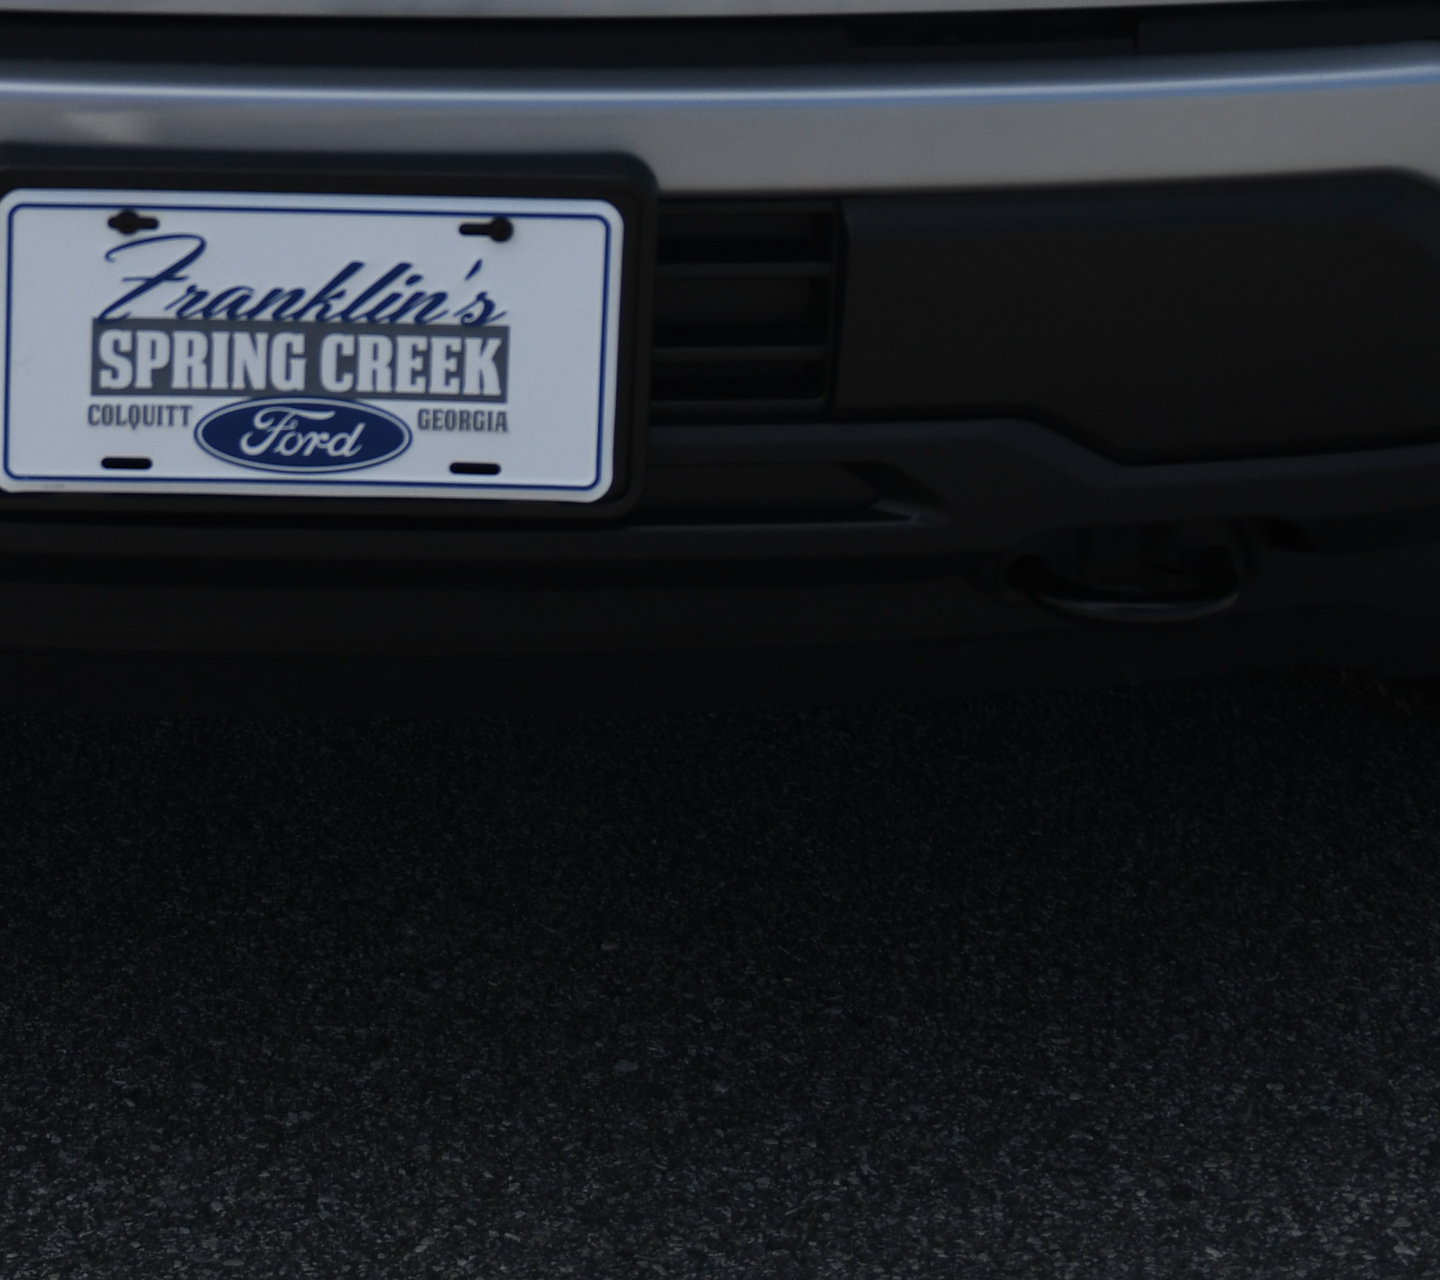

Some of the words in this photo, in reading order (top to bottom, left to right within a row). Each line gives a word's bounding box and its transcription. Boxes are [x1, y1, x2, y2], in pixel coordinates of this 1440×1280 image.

[98, 233, 508, 326] Franklin's
[99, 329, 307, 392] SPRING
[322, 333, 503, 396] CREEK
[88, 404, 192, 430] COLQUITT
[239, 405, 366, 458] Ford
[418, 408, 509, 432] GEORGIA
